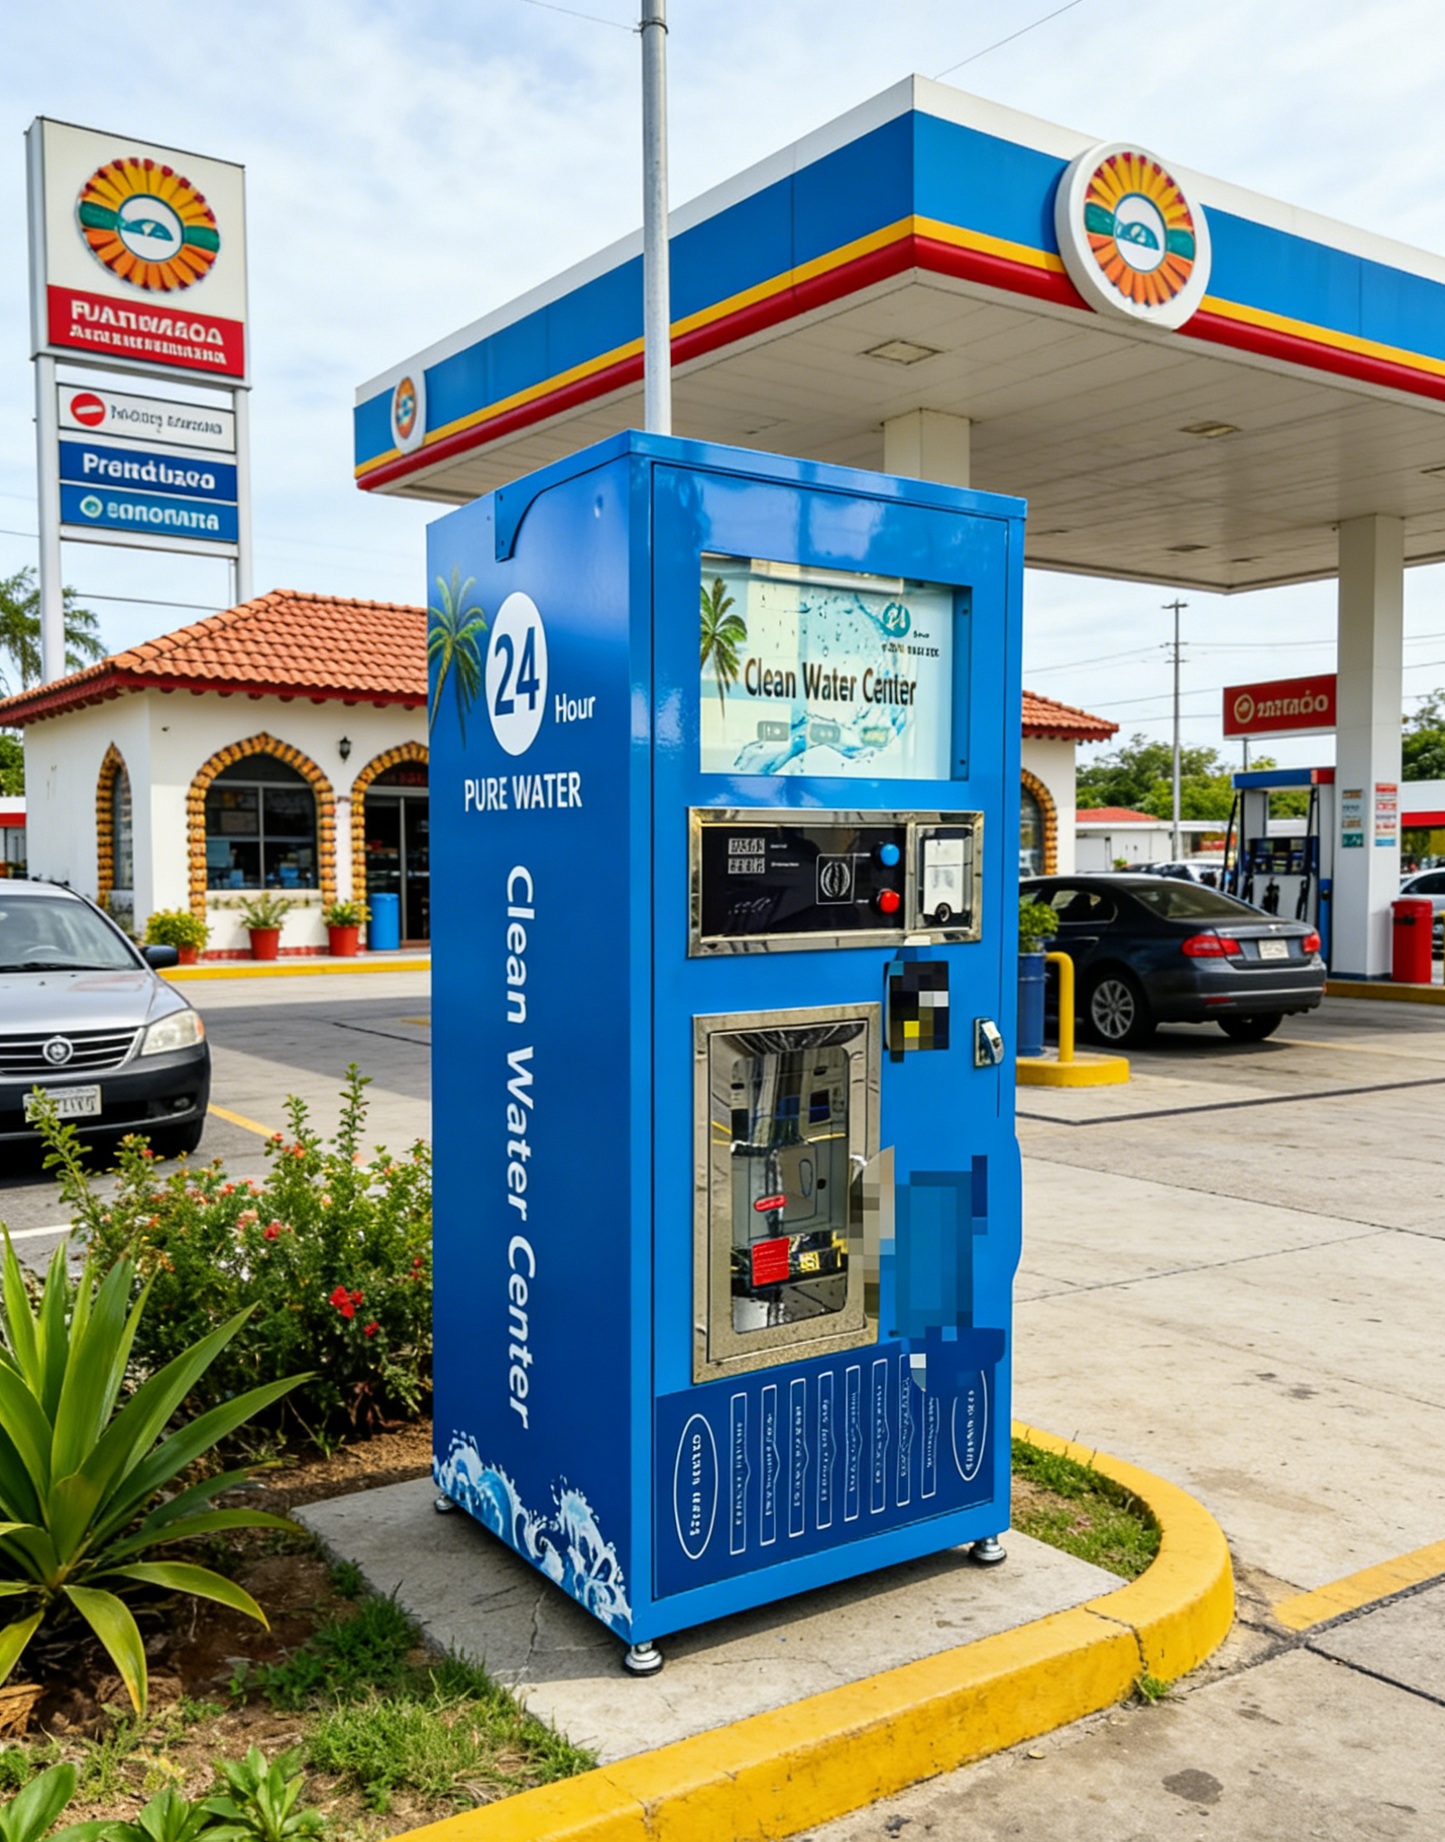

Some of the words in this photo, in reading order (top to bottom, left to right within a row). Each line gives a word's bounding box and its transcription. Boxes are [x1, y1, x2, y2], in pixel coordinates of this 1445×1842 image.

[494, 626, 540, 716] 24
[556, 694, 595, 722] Hour
[744, 658, 796, 699] Clean
[802, 662, 857, 702] Water
[862, 668, 917, 706] Center
[465, 777, 507, 811] PURE
[513, 772, 581, 808] WATER
[507, 866, 534, 1022] Clean
[508, 1047, 533, 1220] Water
[509, 1236, 535, 1428] Center
